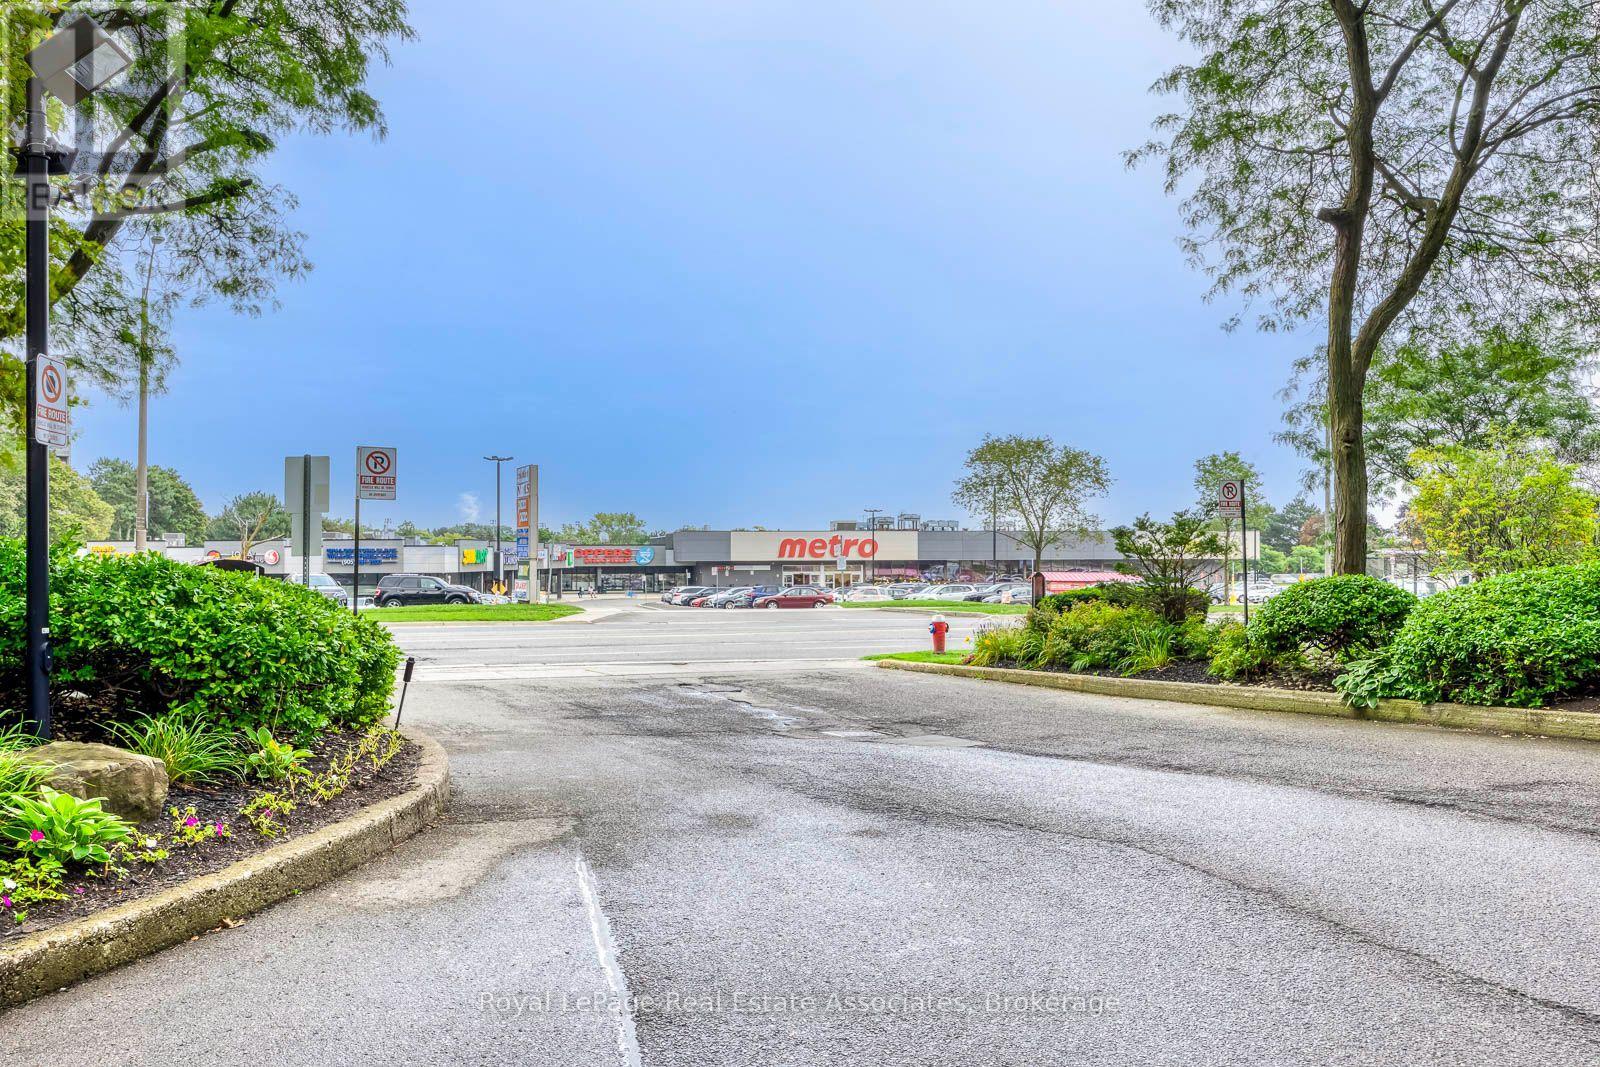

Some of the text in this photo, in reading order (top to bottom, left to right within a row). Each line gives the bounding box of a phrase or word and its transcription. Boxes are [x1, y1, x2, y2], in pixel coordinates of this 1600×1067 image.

[48, 409, 66, 422] ROUTE
[361, 476, 395, 485] FIRE ROUTE
[778, 535, 879, 558] metro
[574, 548, 632, 559] OPPERS
